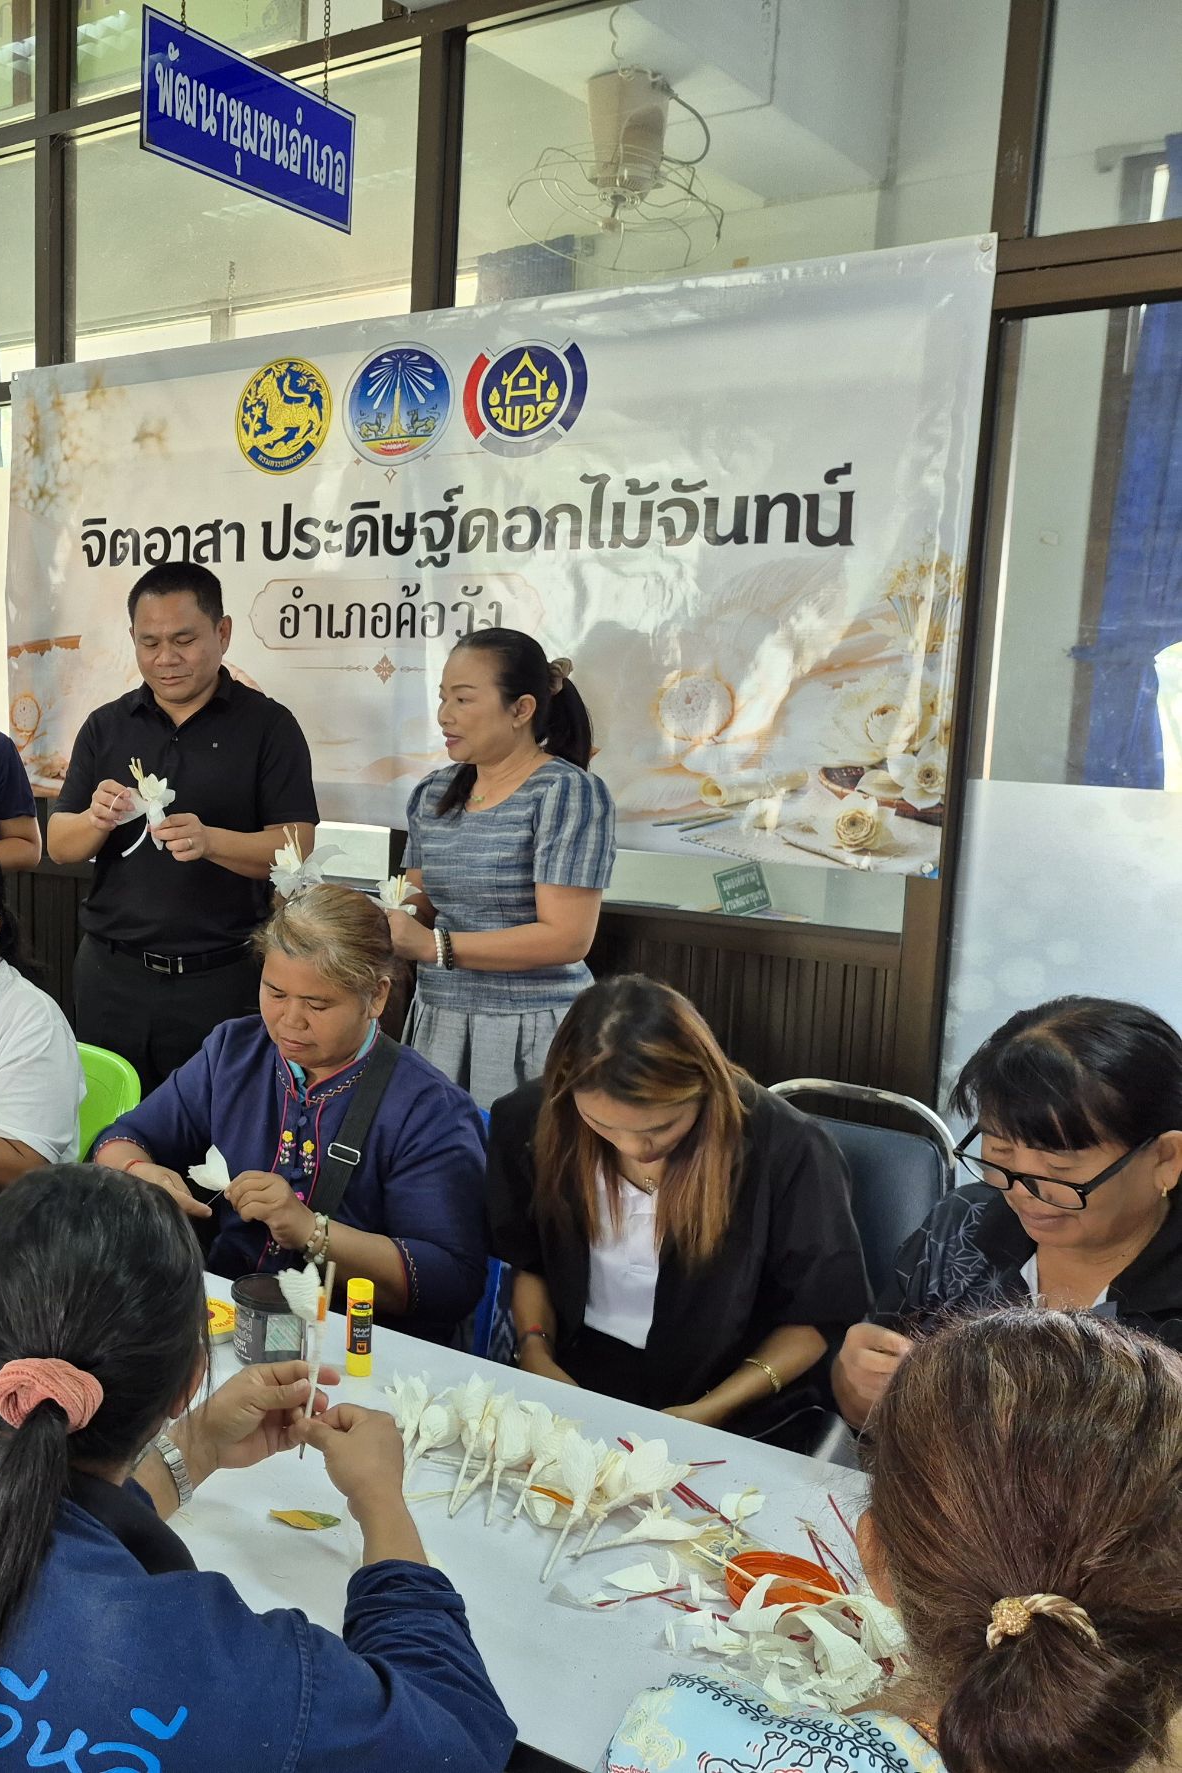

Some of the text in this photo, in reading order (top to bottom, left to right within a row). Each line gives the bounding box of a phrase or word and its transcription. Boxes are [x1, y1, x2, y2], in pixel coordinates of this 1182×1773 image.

[154, 41, 347, 196] พัฒนาชุมชนอำเภอ
[80, 462, 856, 569] จิตอาสา ประดิษฐ์ดอกไม้จันทน์
[278, 583, 503, 640] อำเภอค้อวัง
